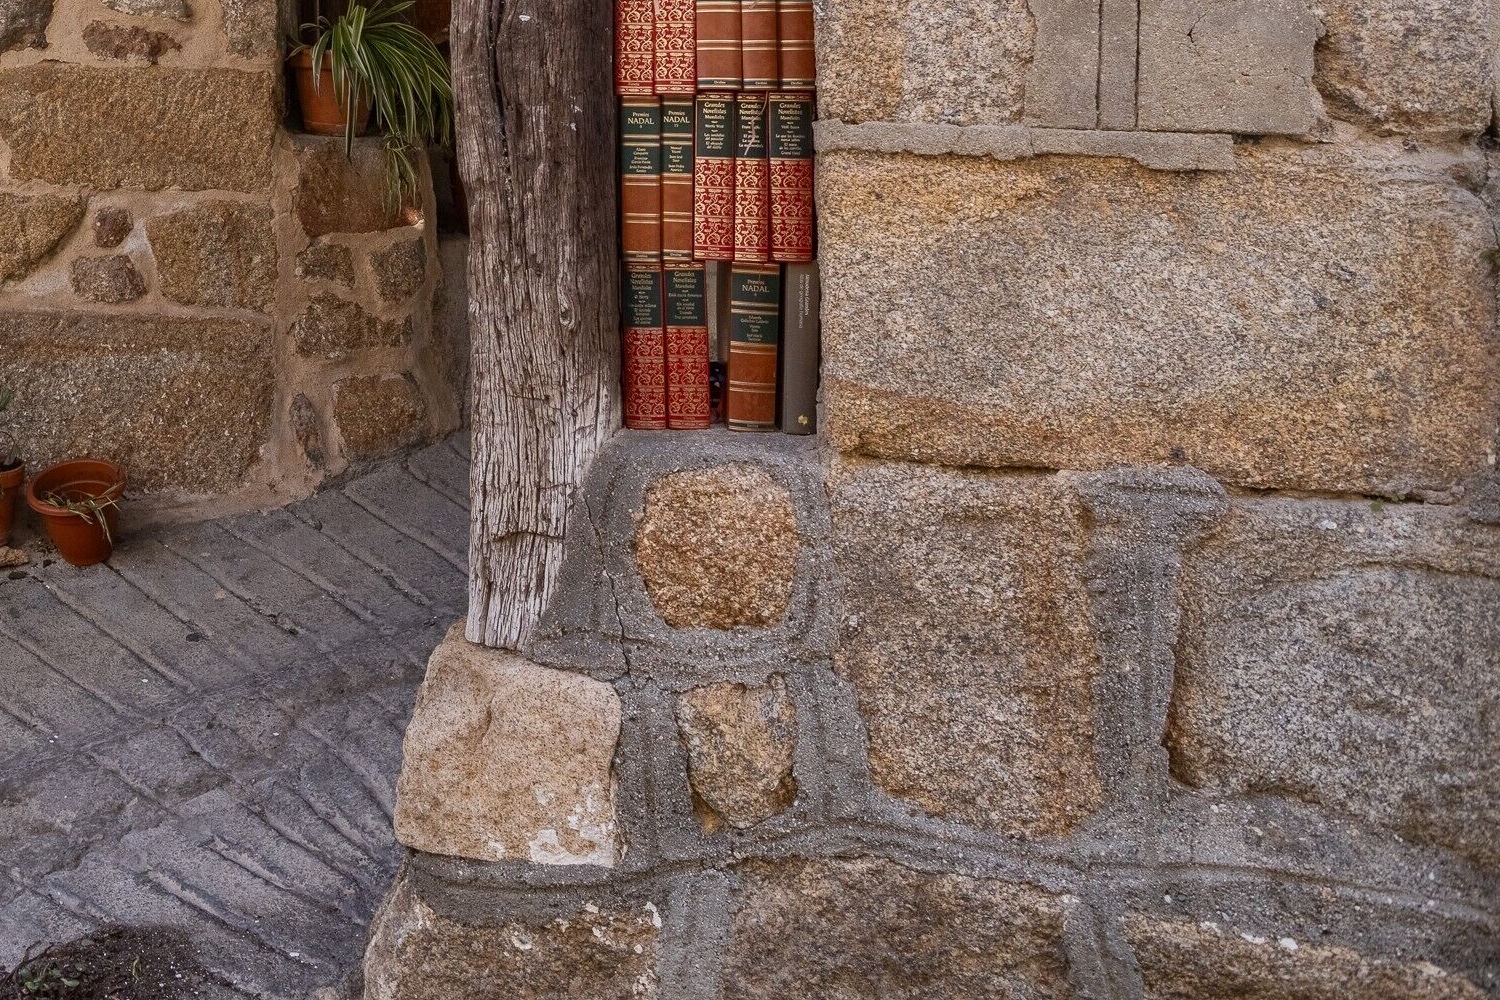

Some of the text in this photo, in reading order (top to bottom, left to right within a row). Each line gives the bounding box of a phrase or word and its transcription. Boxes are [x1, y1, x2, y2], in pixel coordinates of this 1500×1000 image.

[627, 117, 655, 125] NADAL
[663, 115, 691, 124] NADAL
[741, 284, 770, 293] NADAL
